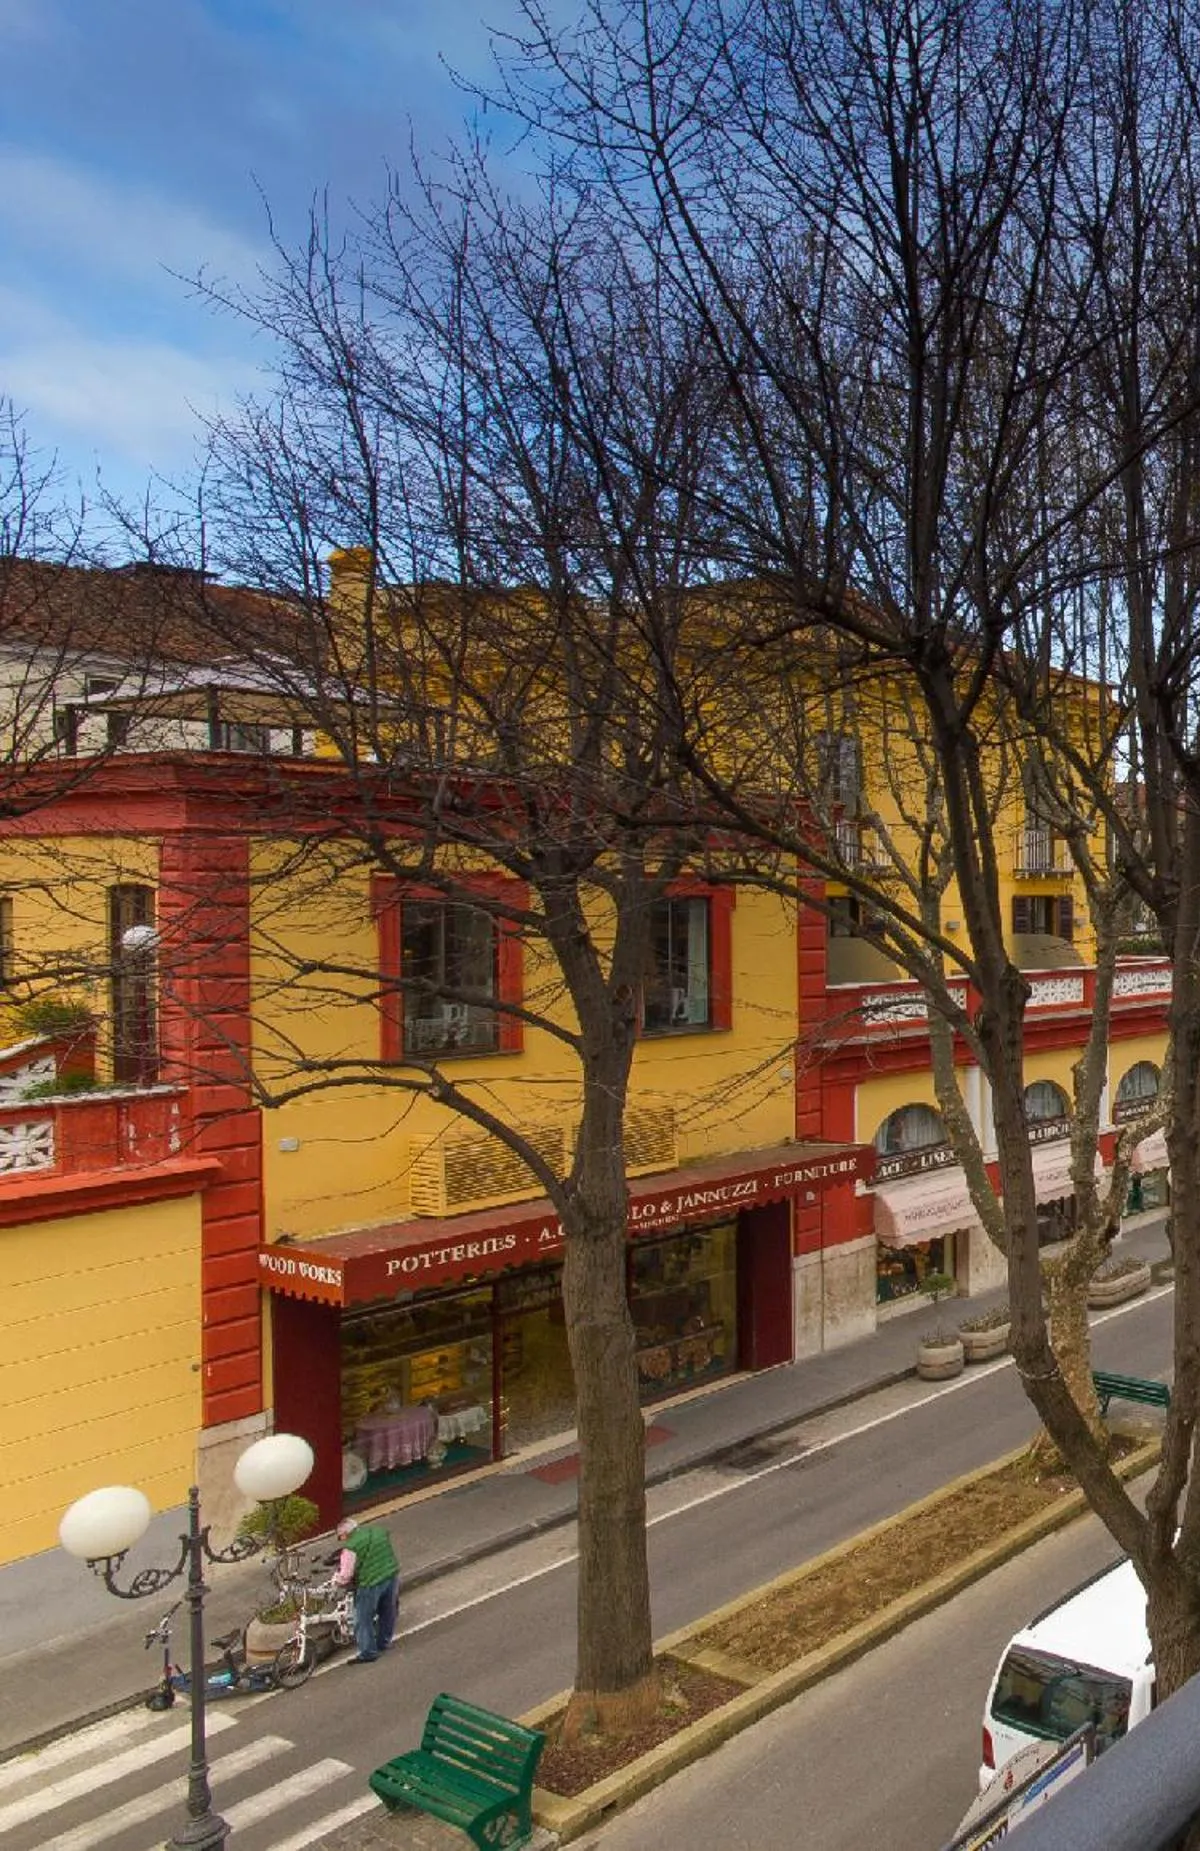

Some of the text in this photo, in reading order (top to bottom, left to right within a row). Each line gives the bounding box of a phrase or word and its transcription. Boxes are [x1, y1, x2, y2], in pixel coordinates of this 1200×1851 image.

[385, 1233, 517, 1277] POTTERIES
[676, 1179, 759, 1214] JANNUZZI
[774, 1157, 858, 1188] FURNITURE
[258, 1253, 343, 1287] WOOD WORKS
